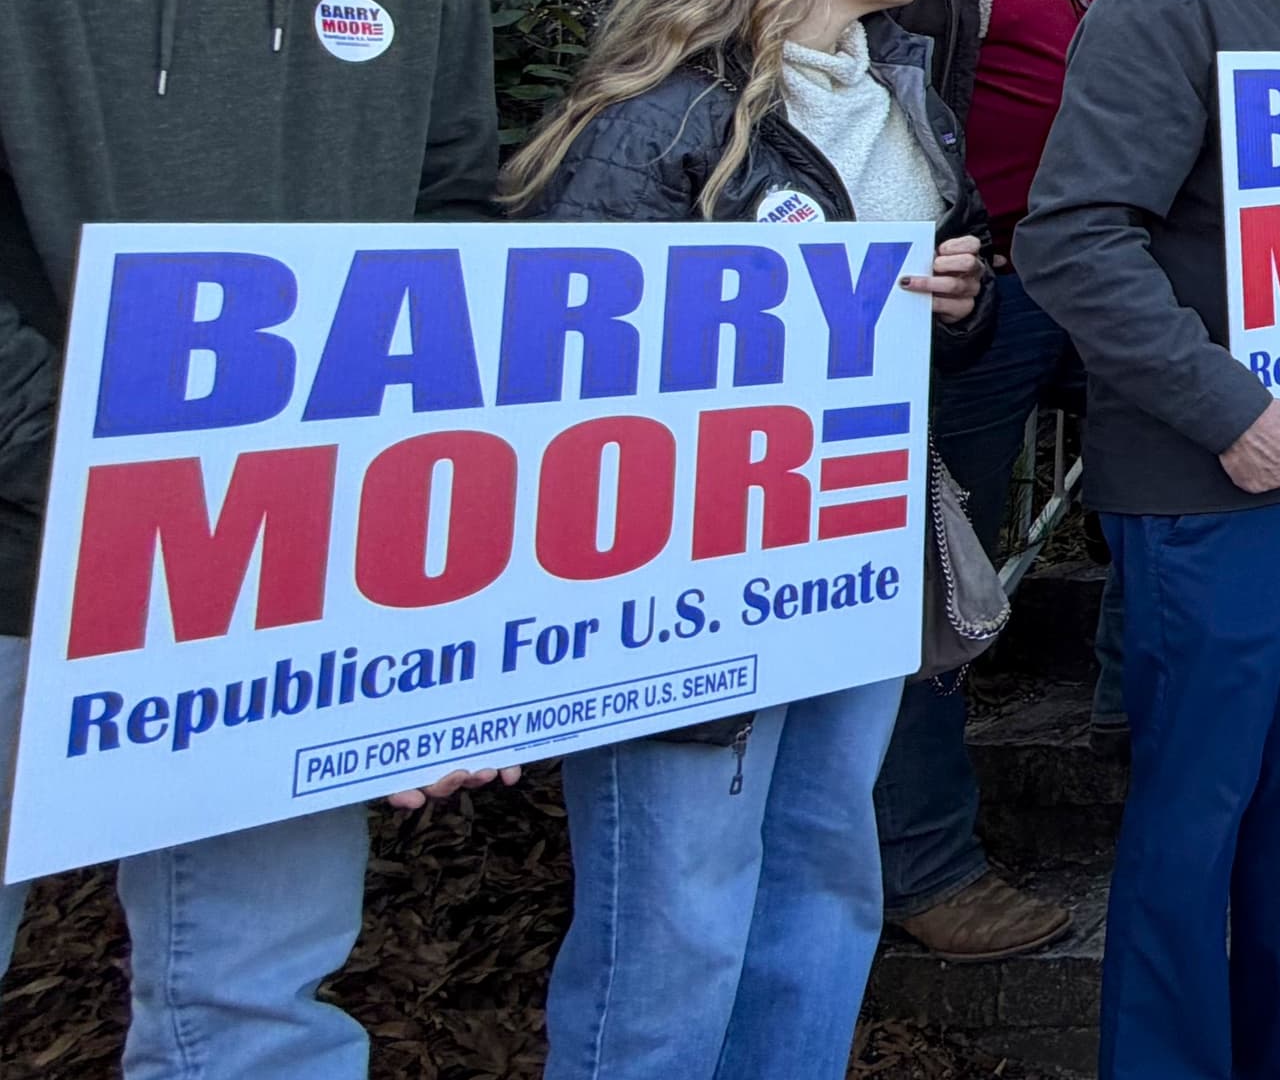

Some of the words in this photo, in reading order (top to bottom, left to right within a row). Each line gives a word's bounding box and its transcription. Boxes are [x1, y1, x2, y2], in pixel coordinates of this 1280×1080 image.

[321, 4, 380, 20] BARRY
[322, 19, 384, 35] MOORE
[92, 242, 913, 438] BARRY
[66, 402, 911, 661] MOORE
[66, 638, 475, 758] Republican
[501, 614, 600, 673] For
[621, 587, 719, 649] U.S.
[742, 560, 900, 628] Senate
[306, 746, 359, 783] PAID
[365, 736, 410, 771] FOR
[417, 731, 447, 760] BY
[450, 716, 520, 751] BARRY
[526, 702, 598, 736] MOORE
[601, 690, 639, 717] FOR
[644, 680, 678, 706] U.S.
[682, 665, 748, 698] SENATE
